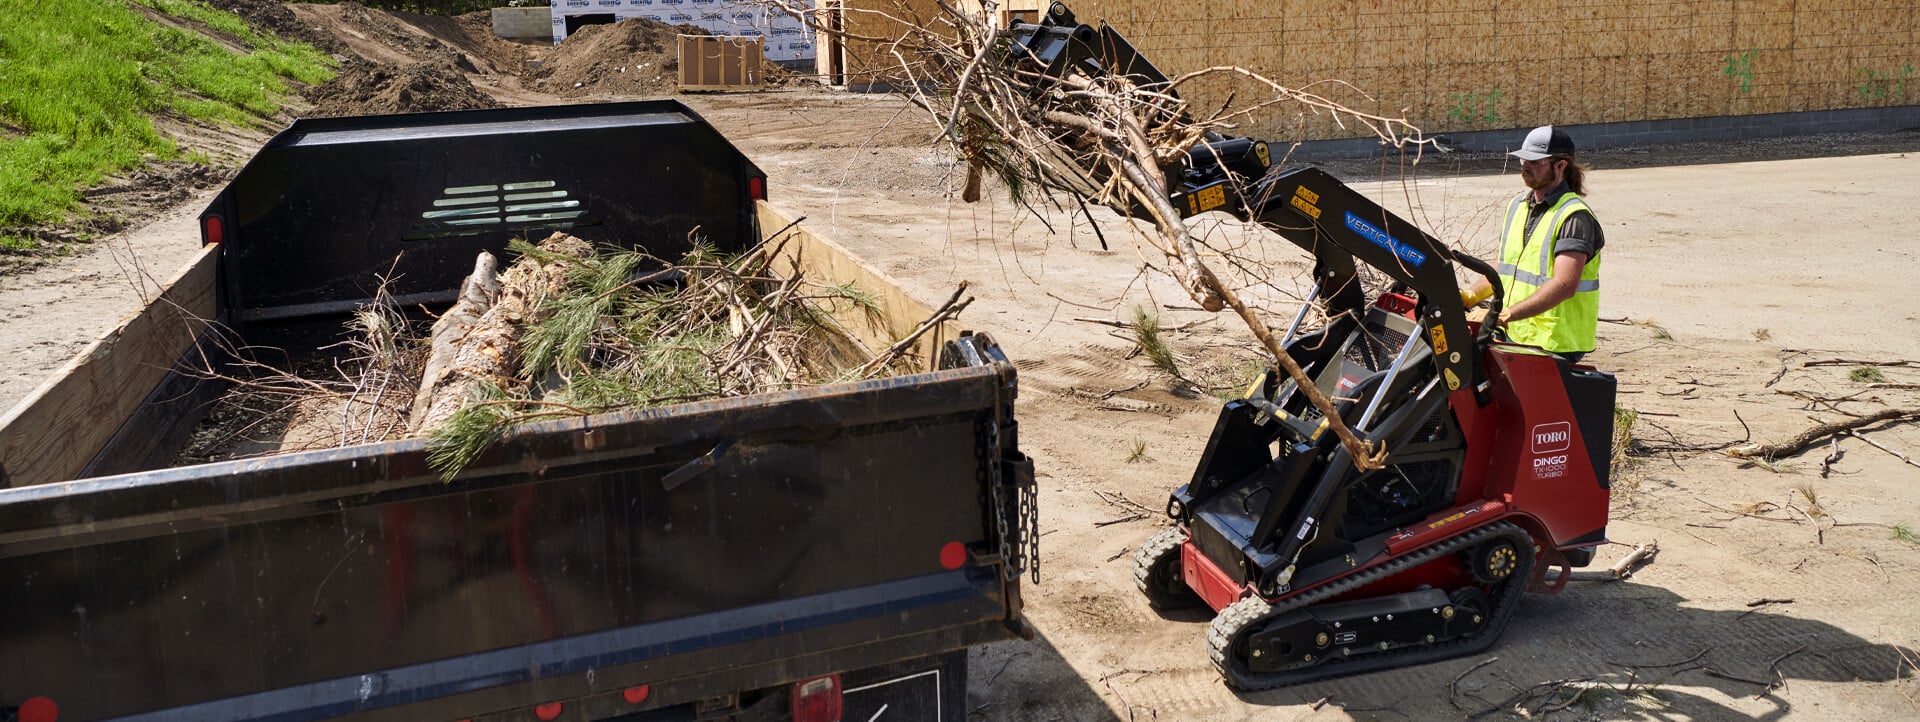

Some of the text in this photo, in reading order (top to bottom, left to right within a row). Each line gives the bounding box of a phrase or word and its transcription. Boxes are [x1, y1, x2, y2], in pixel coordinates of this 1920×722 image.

[1346, 214, 1424, 264] VERTICAL LIFT
[1536, 431, 1567, 444] TORO
[1533, 455, 1567, 467] DINGO
[1537, 471, 1562, 479] TURBO
